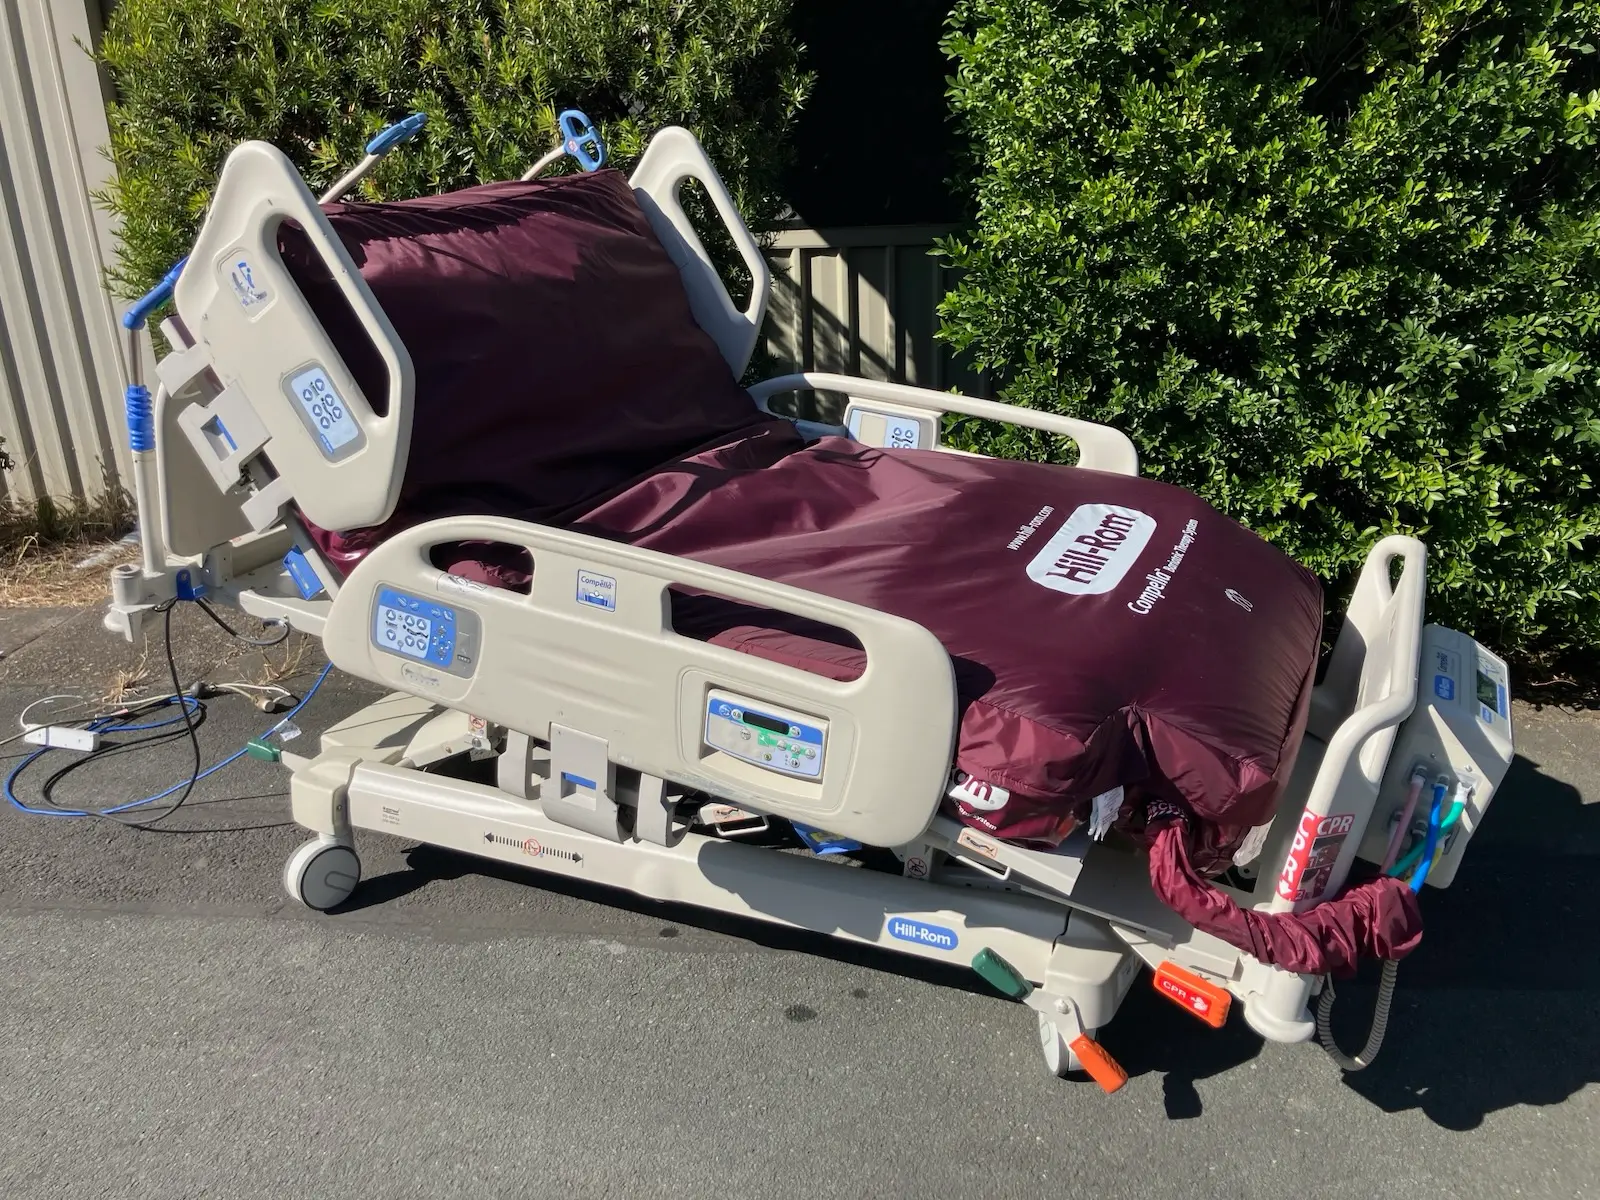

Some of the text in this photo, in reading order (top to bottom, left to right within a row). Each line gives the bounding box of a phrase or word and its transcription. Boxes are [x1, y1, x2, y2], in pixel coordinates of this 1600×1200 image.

[1007, 505, 1055, 551] www.hill-rom.com
[1182, 519, 1198, 535] System
[1046, 513, 1137, 585] Hill-Rom
[1174, 533, 1194, 553] Therapy
[1163, 551, 1184, 573] Bariatric
[1317, 816, 1353, 835] CPR
[1282, 811, 1316, 884] CPR
[895, 922, 951, 946] Hill-Rom
[1163, 980, 1187, 999] CPR
